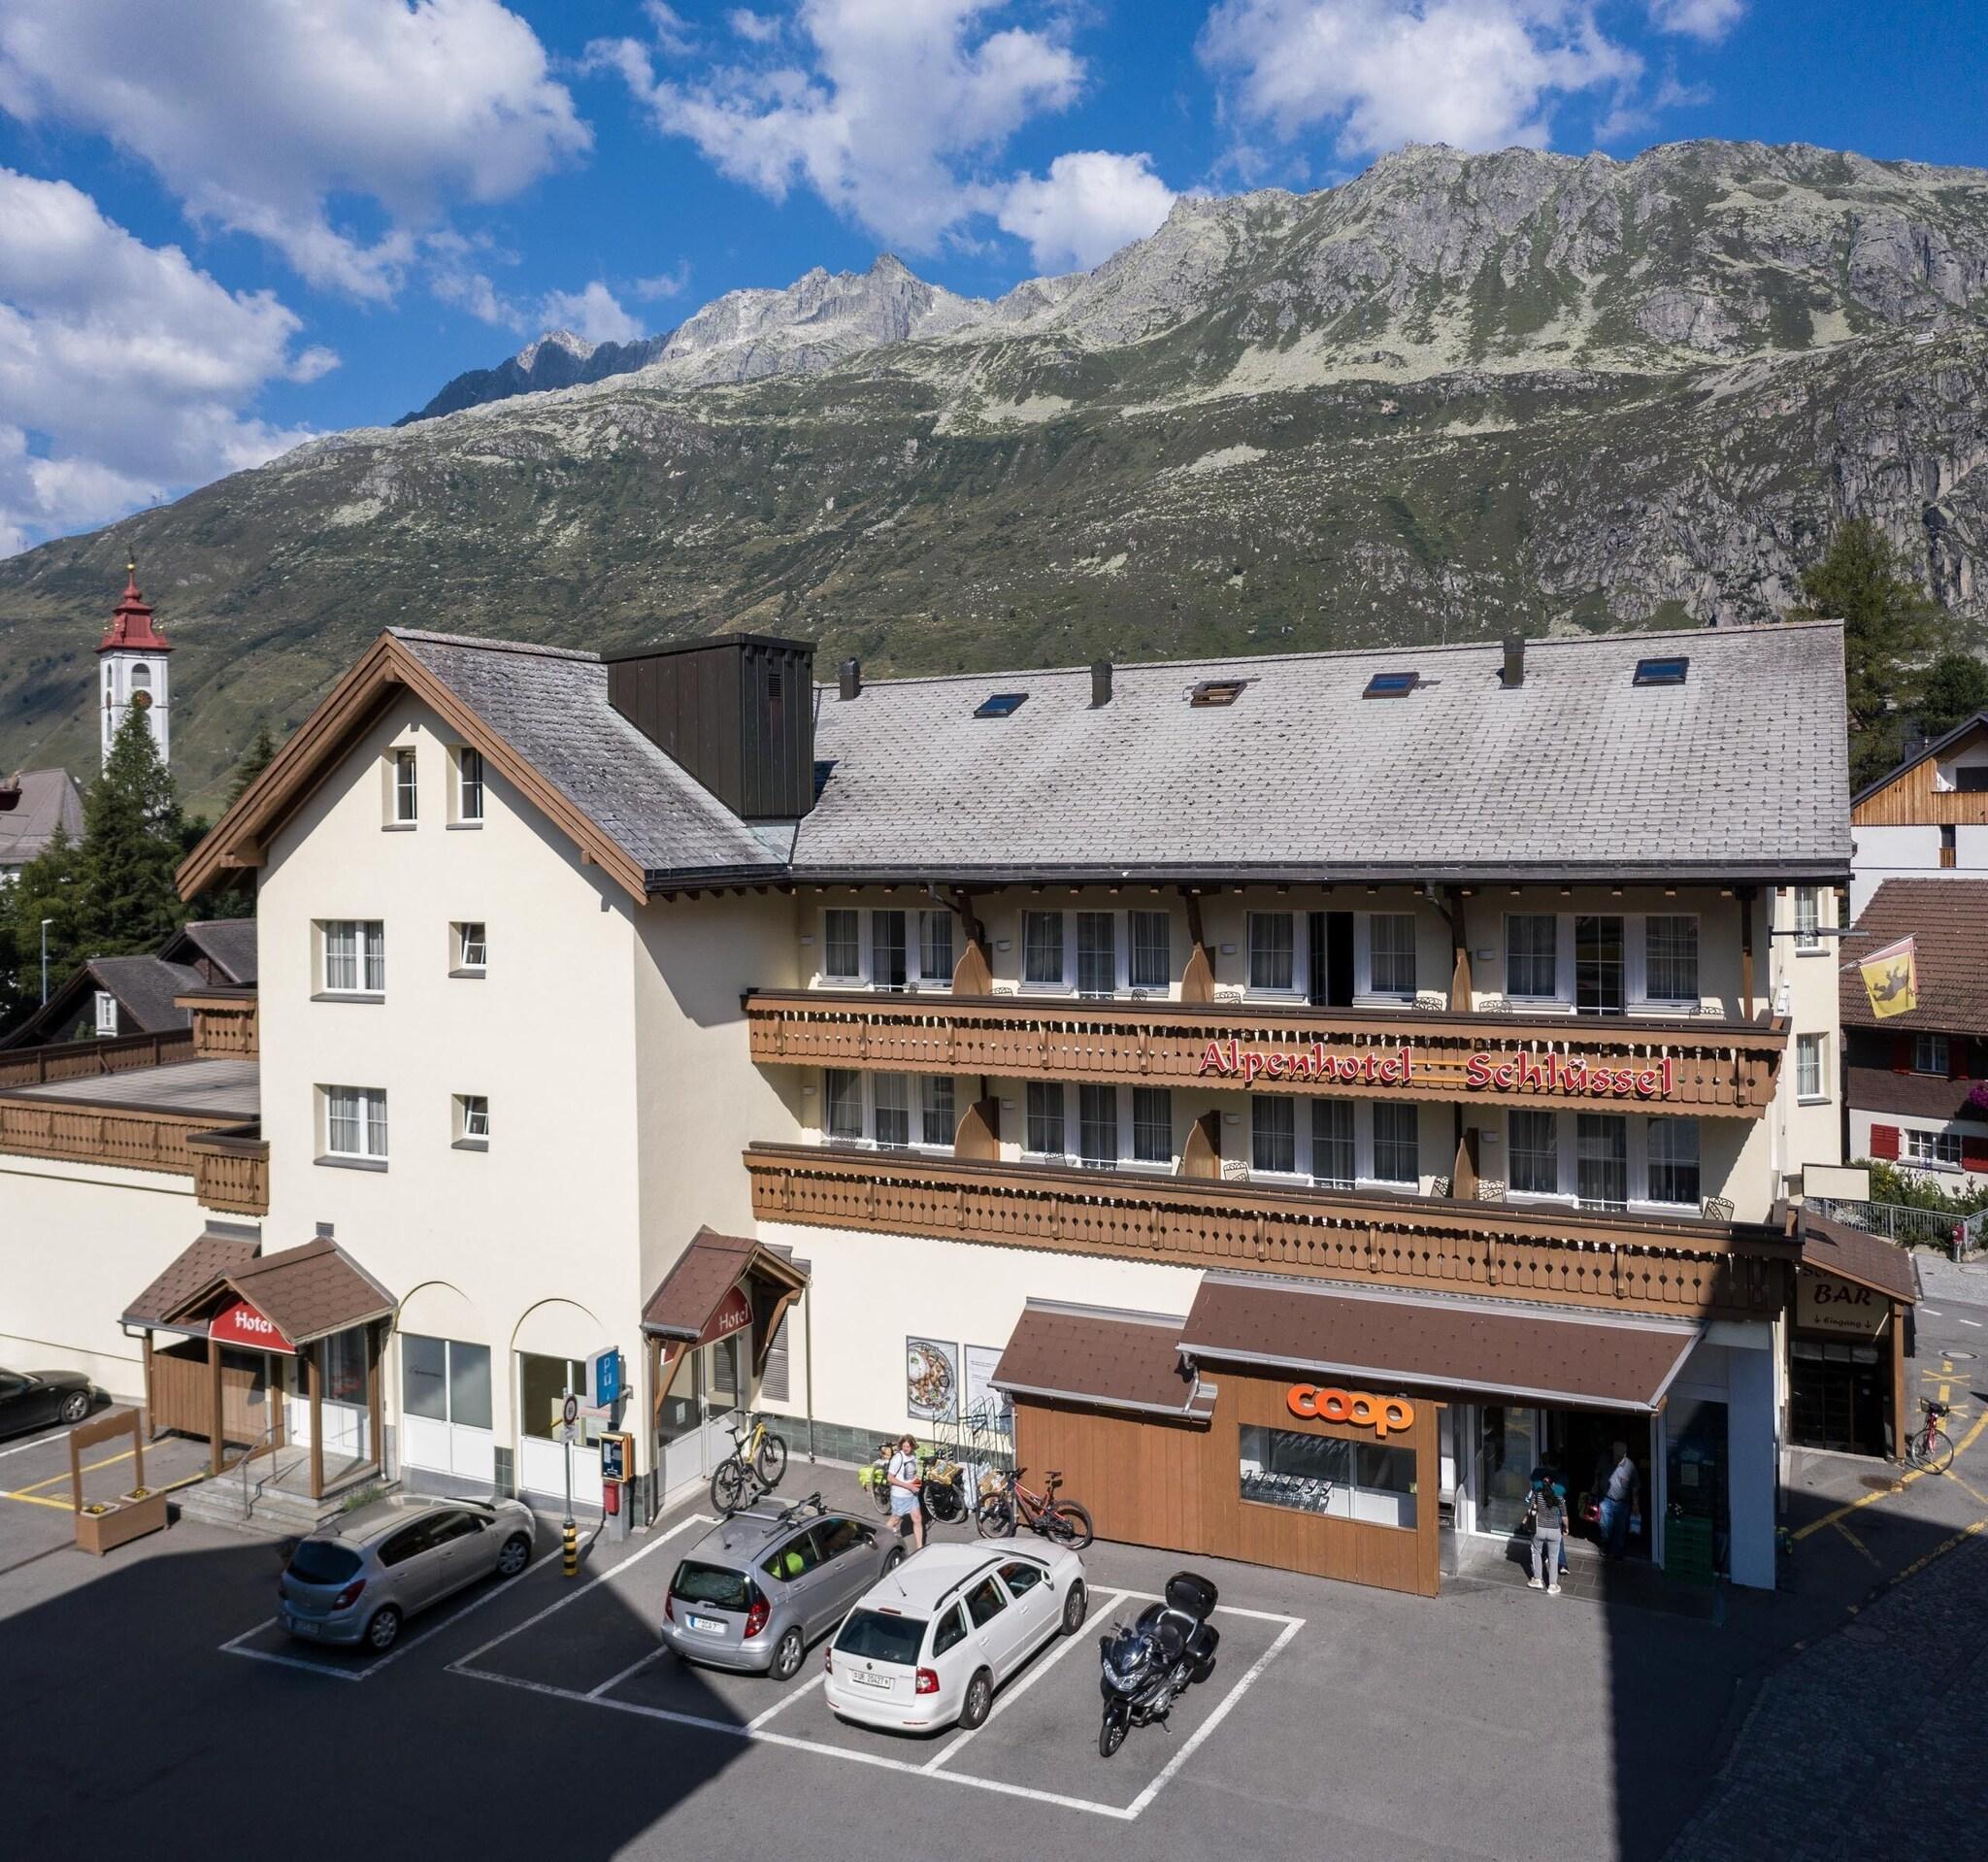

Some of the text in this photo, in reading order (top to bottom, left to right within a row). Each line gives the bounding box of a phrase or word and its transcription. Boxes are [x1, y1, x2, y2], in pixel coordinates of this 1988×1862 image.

[1198, 1039, 1673, 1095] Alpenhotel Schlüssel
[1813, 1283, 1872, 1306] BAR
[719, 1302, 748, 1332] Hotel
[1823, 1316, 1861, 1329] Eingang
[604, 1357, 611, 1374] P
[1287, 1383, 1414, 1438] coop
